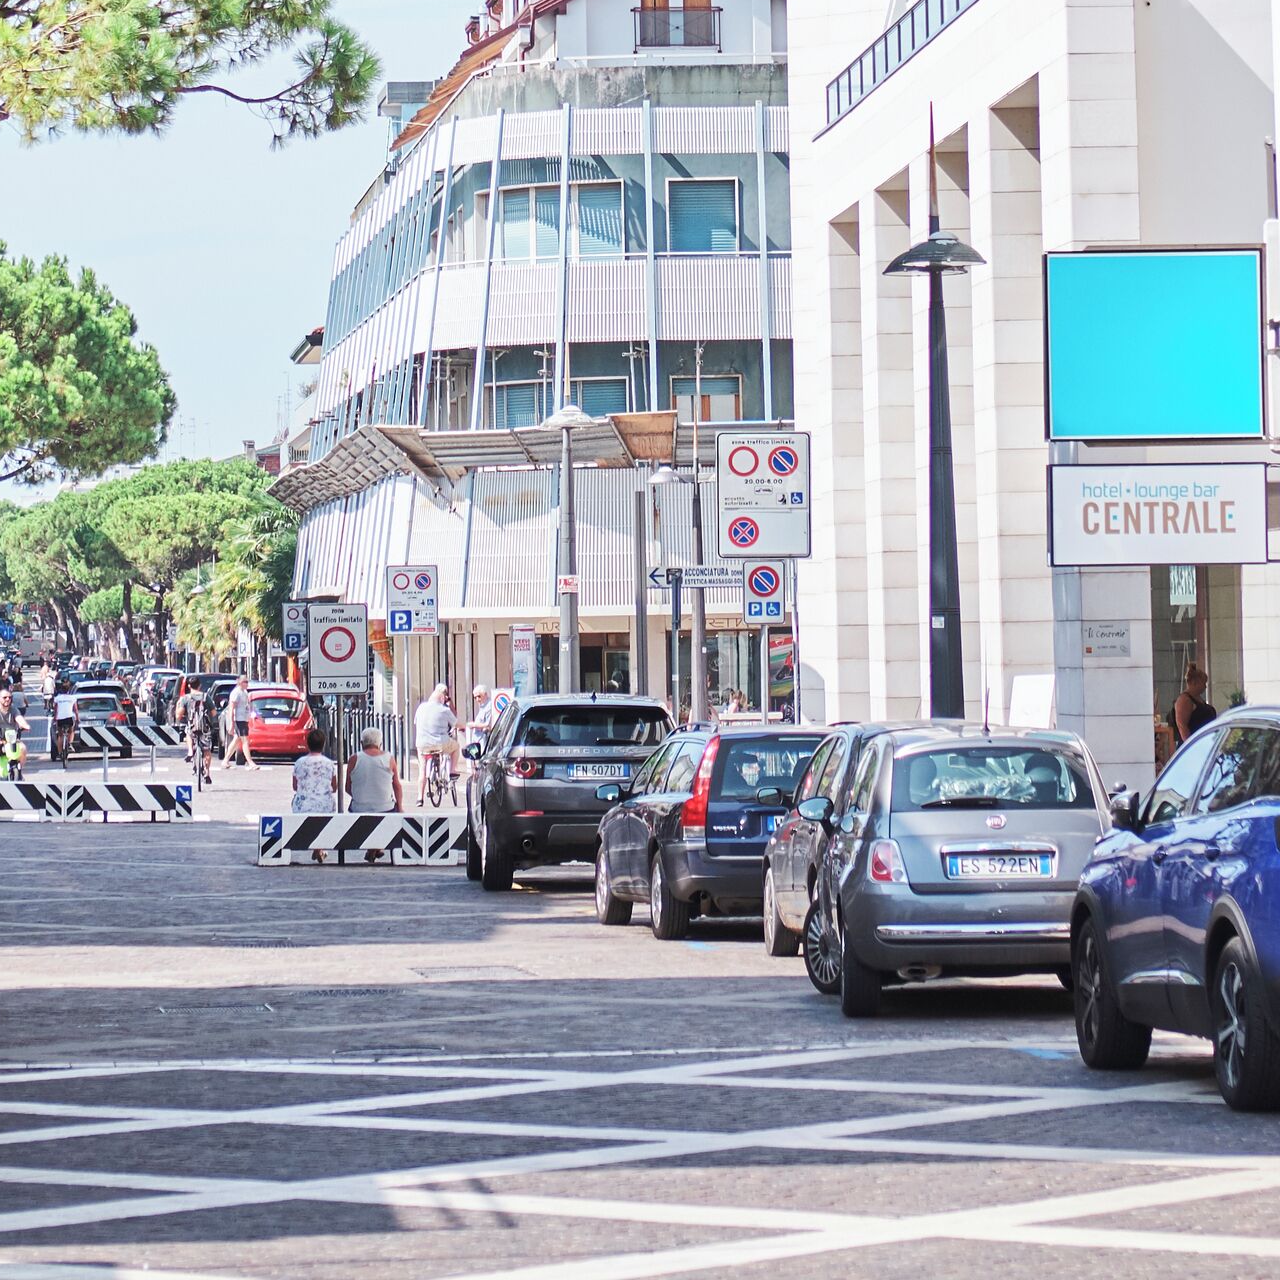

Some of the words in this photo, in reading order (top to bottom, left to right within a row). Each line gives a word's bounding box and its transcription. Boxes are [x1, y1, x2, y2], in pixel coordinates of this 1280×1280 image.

[1082, 482, 1122, 498] hotel
[1134, 481, 1189, 500] lounge
[1193, 481, 1219, 498] bar
[1082, 500, 1236, 535] CENTRALE
[684, 567, 729, 577] ACCONCIATURA
[751, 605, 760, 614] P
[313, 616, 338, 624] traffico
[395, 612, 407, 629] P
[289, 635, 298, 647] P
[960, 858, 980, 874] ES
[988, 857, 1039, 874] 522EN
